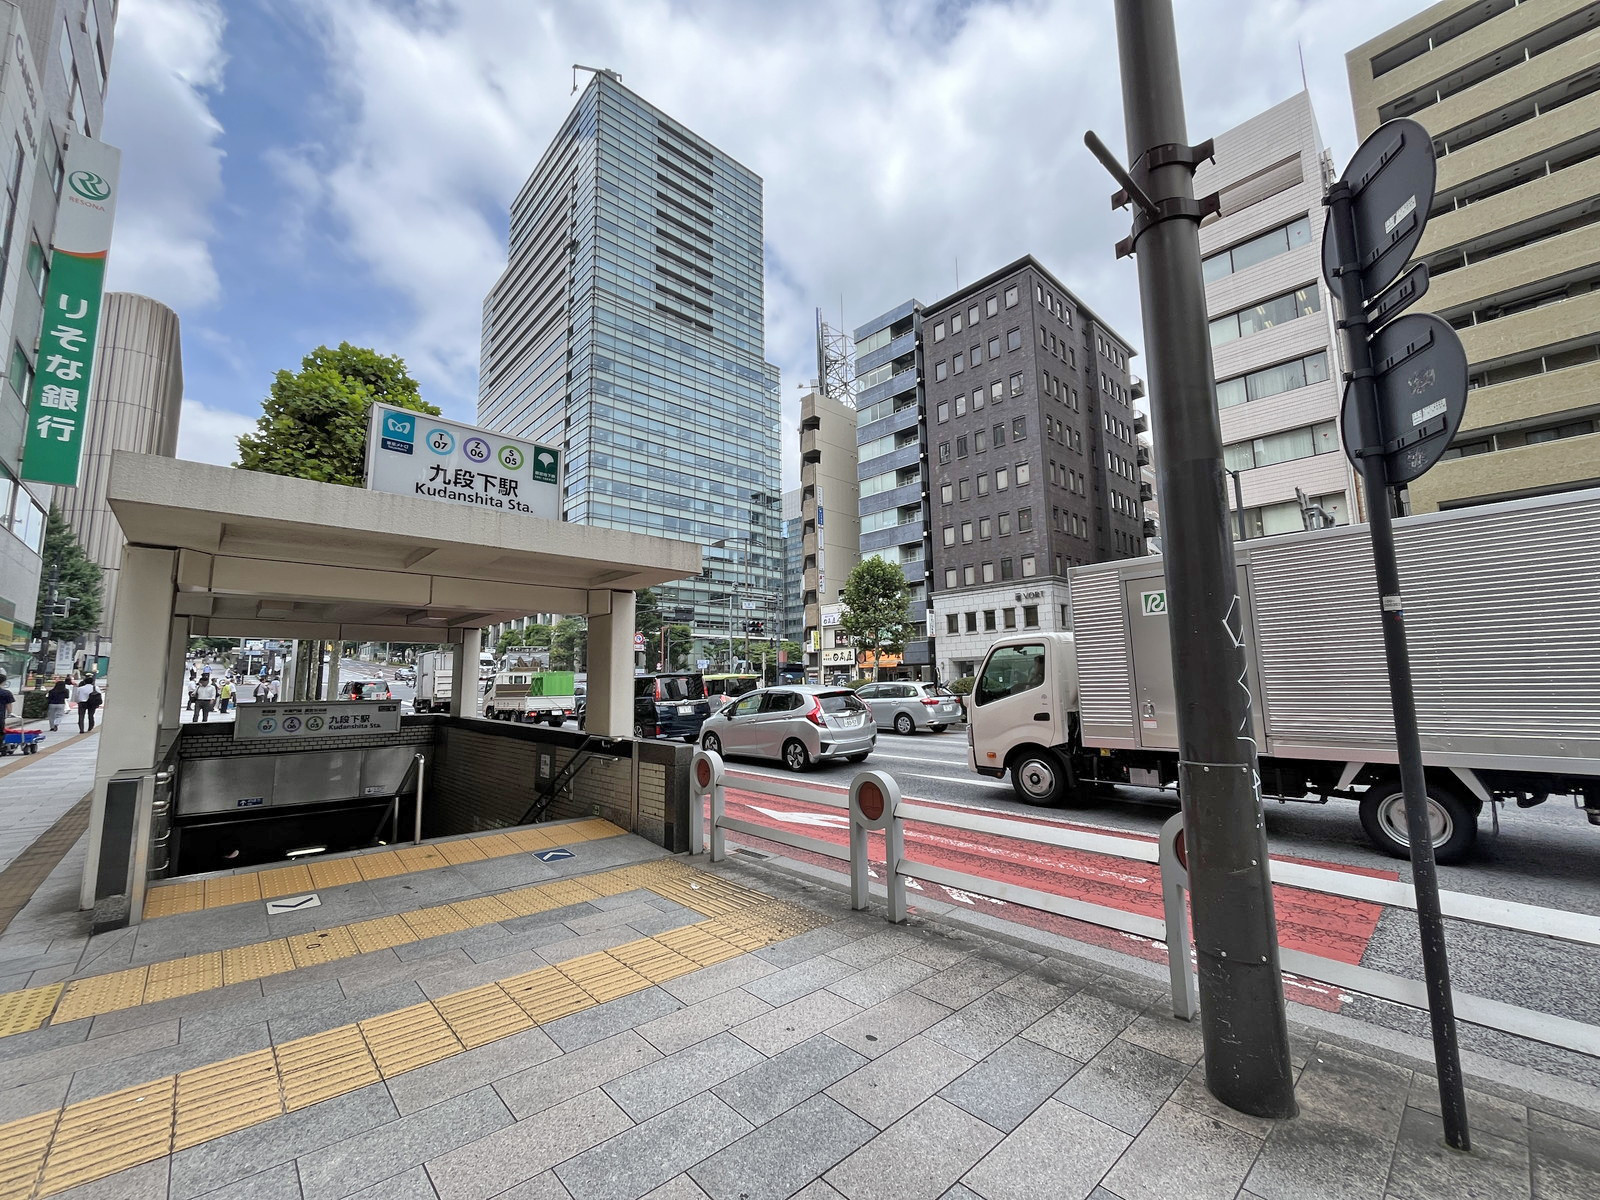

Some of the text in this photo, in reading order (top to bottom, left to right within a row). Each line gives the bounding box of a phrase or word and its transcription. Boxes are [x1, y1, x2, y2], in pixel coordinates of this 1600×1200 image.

[69, 196, 105, 212] RESONA
[36, 293, 88, 444] りそな銀行
[438, 433, 445, 441] T
[433, 441, 448, 450] 07
[474, 442, 481, 450] Z
[470, 449, 484, 459] 06
[504, 457, 517, 466] 05
[428, 464, 519, 498] 九段下駅
[415, 481, 534, 514] Kudanshita Sta.
[329, 714, 371, 724] 九段下駅
[328, 722, 368, 730] Kudanshita
